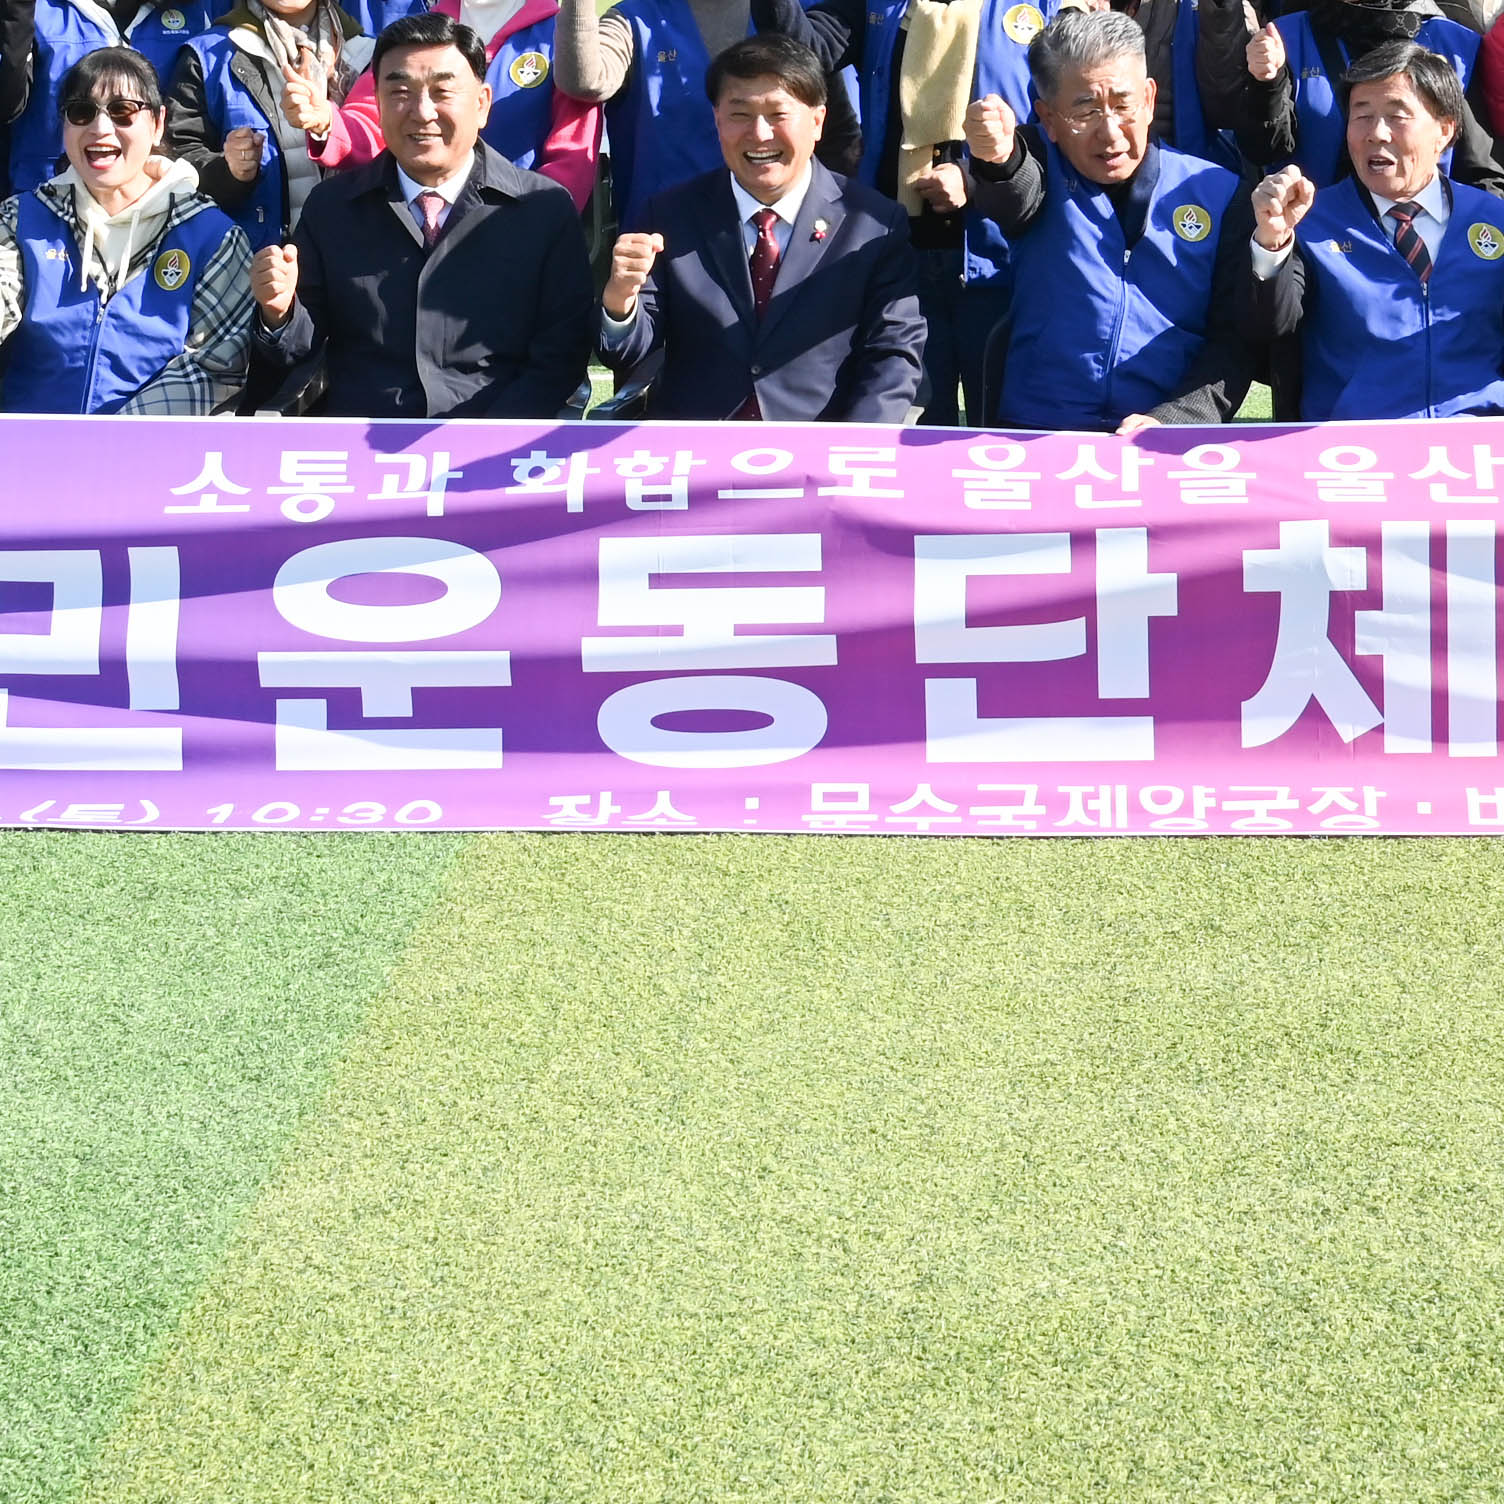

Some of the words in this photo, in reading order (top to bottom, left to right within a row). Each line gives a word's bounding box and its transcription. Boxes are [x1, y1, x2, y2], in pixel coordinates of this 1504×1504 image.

[657, 48, 678, 63] 울산
[164, 451, 463, 523] 소통과
[505, 446, 905, 513] 화합으로
[952, 443, 1257, 510] 울산을
[205, 801, 442, 825] 10:30
[541, 791, 699, 825] 장소
